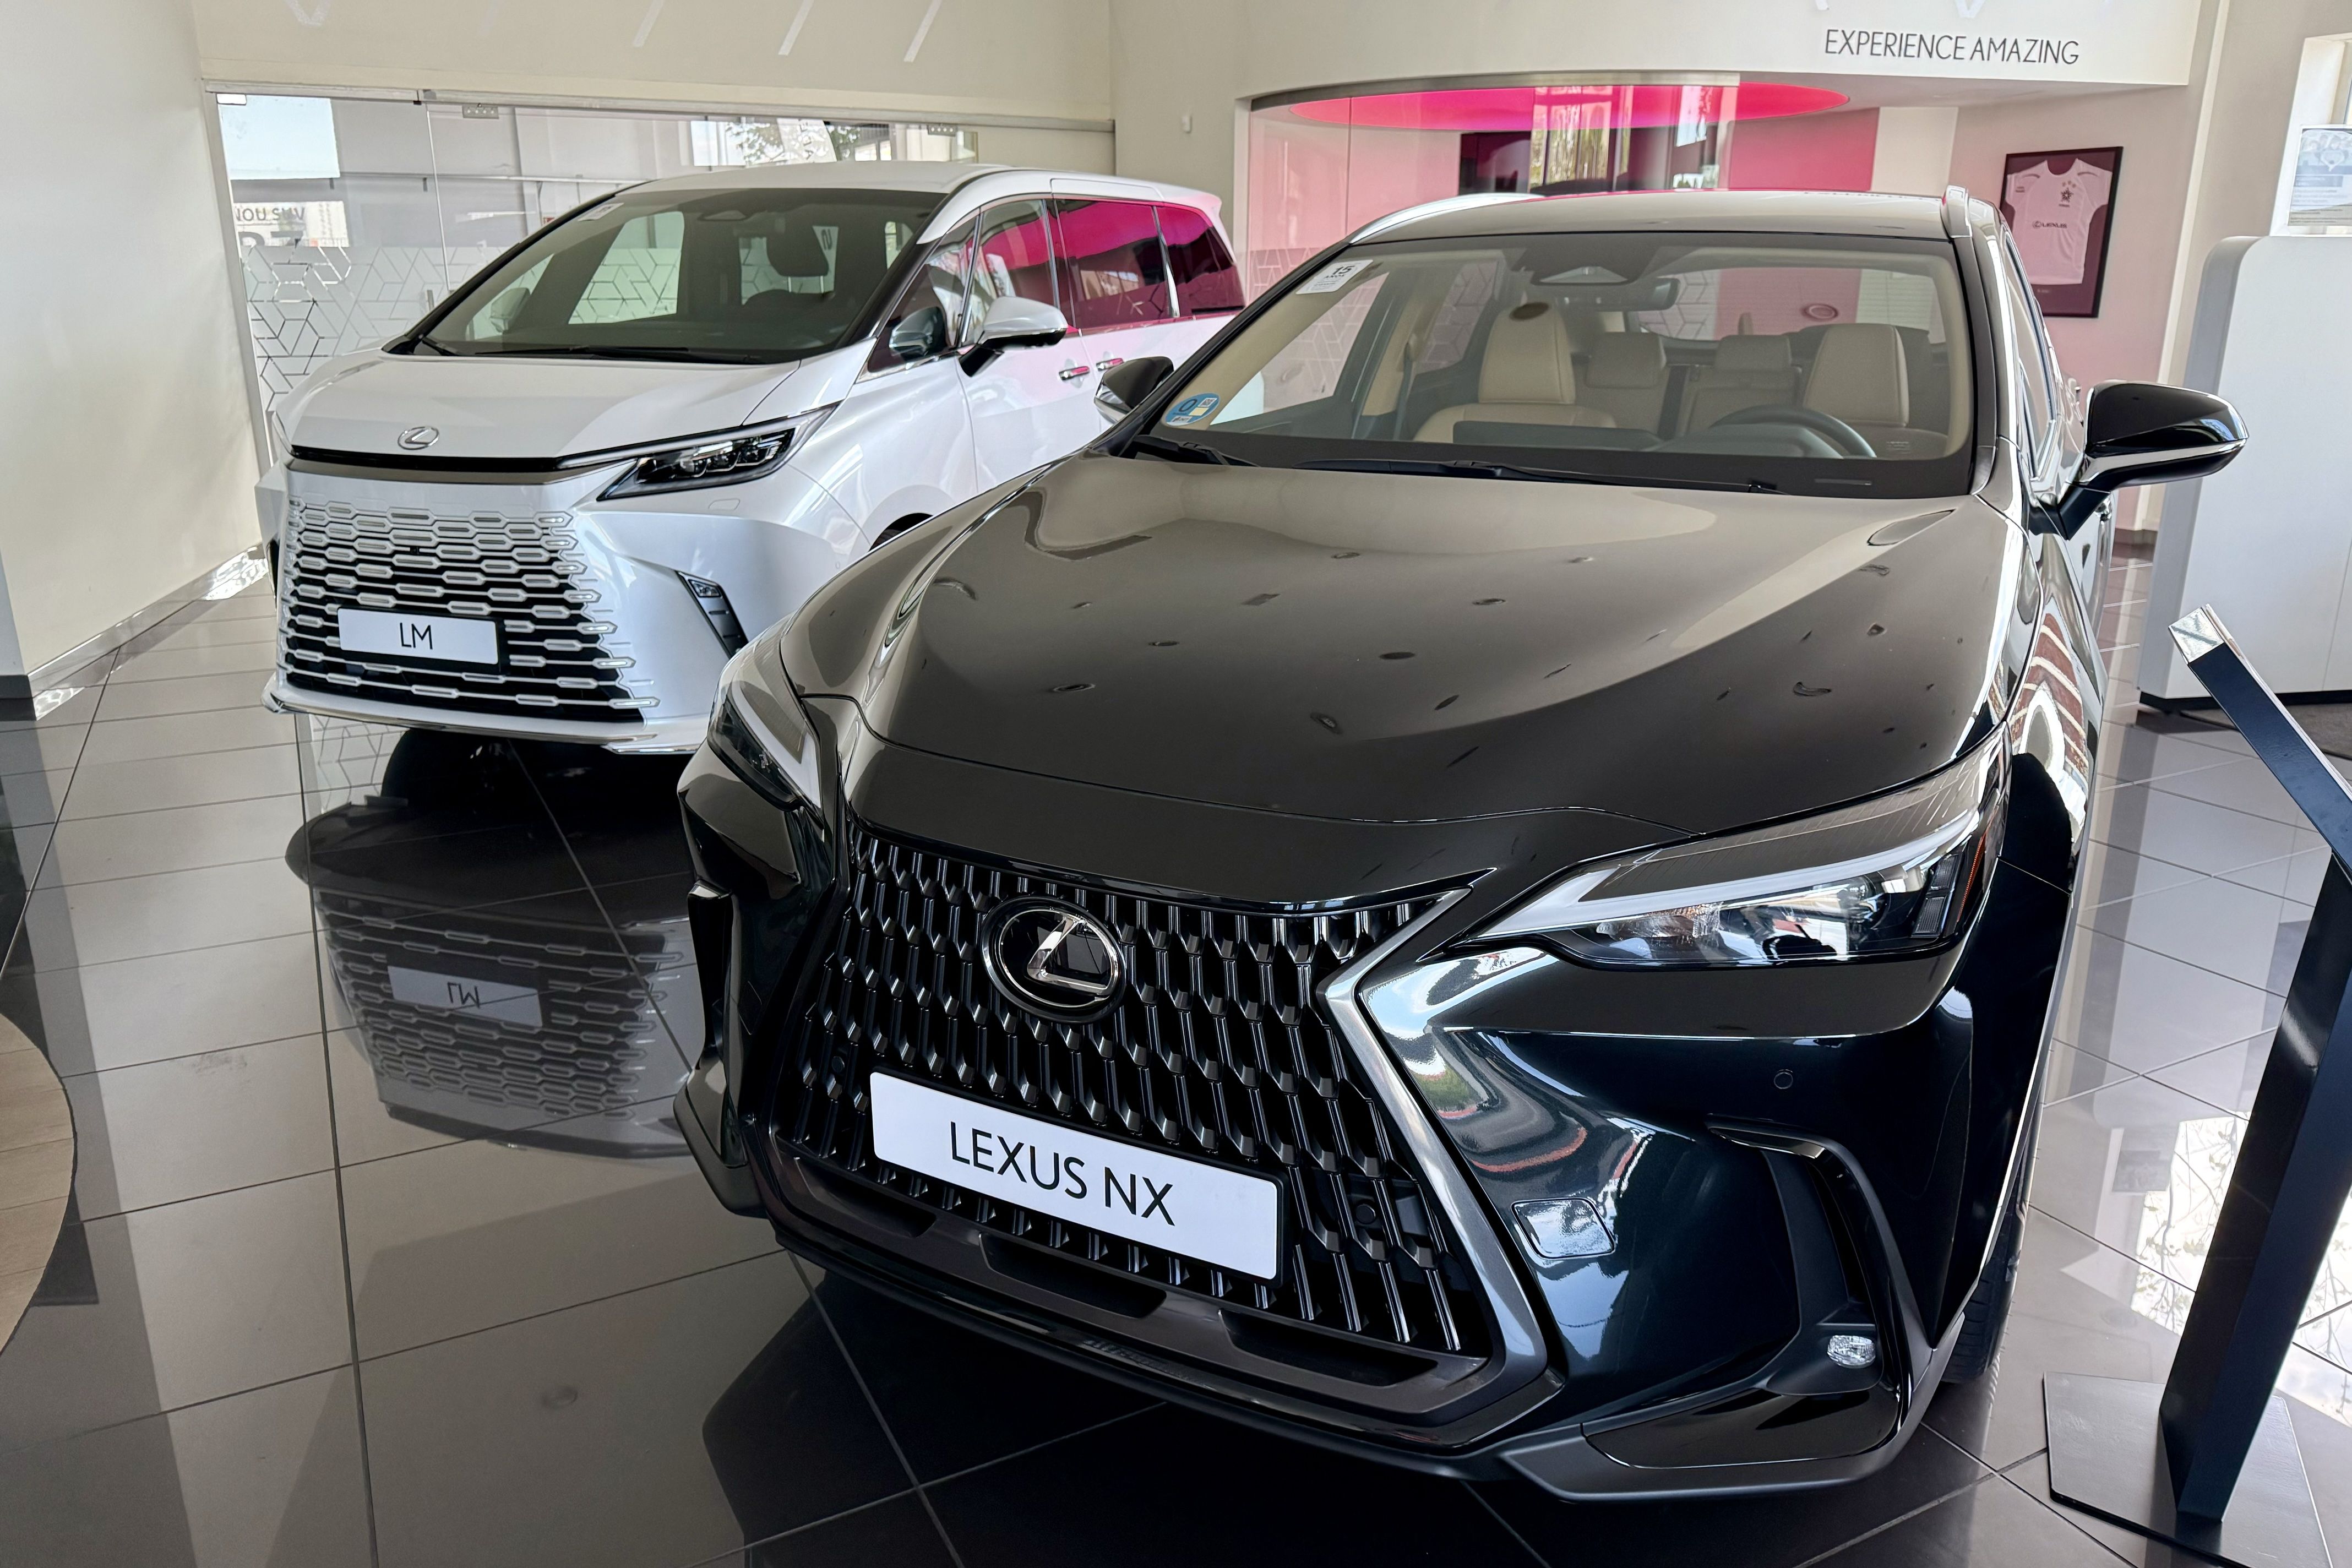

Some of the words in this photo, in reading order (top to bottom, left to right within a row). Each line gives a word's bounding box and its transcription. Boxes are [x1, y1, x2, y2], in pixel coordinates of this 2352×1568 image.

[1825, 29, 1967, 60] EXPERIENCE
[1970, 36, 2079, 64] AMAZING
[1332, 265, 1355, 275] 15
[400, 622, 433, 650] LM
[951, 1121, 1087, 1199] LEXUS
[1105, 1166, 1175, 1226] NX
